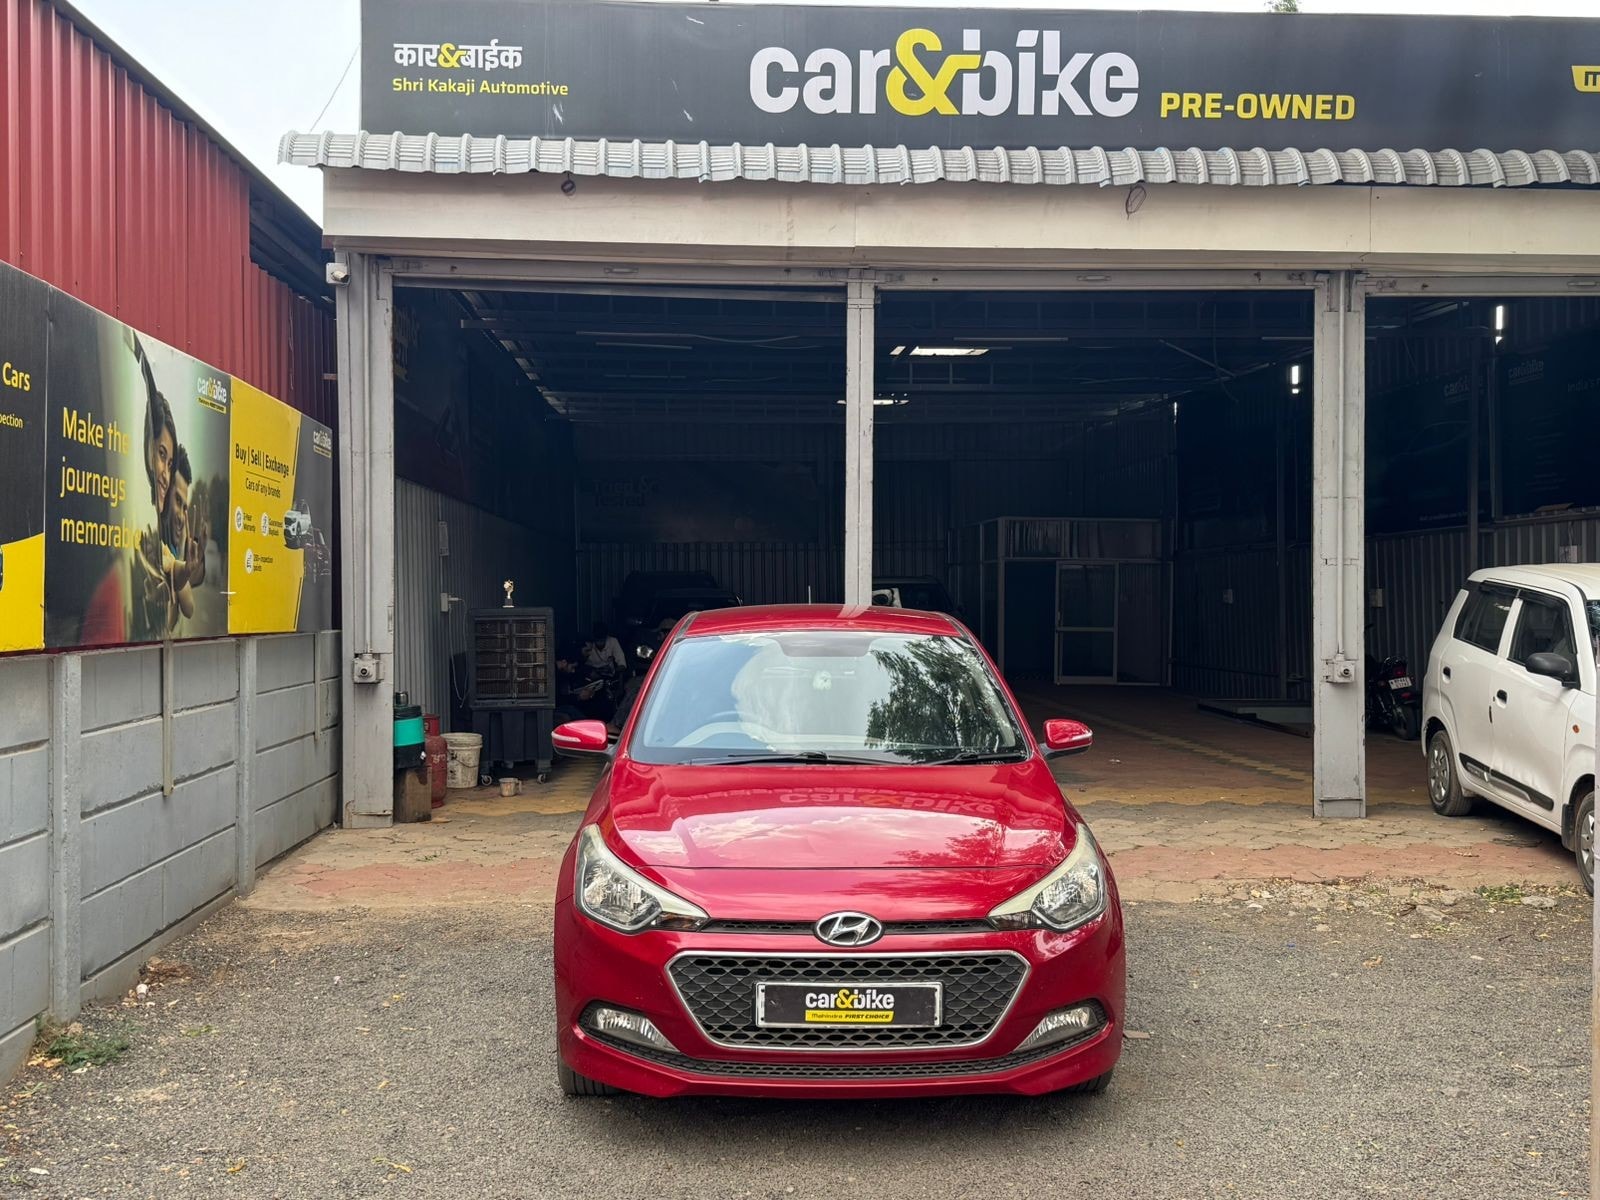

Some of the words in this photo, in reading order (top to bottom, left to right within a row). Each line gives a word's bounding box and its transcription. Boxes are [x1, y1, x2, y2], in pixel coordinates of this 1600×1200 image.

[393, 38, 523, 71] कार&बाईक
[392, 78, 424, 92] Shri
[428, 79, 475, 96] Kakaji
[479, 80, 569, 96] Automotive
[749, 27, 1140, 118] car&bike
[1160, 92, 1356, 121] PRE-OWNED
[2, 361, 31, 392] Cars
[62, 406, 104, 448] Make
[108, 421, 130, 456] the
[235, 442, 247, 464] Buy
[251, 448, 262, 466] Sell
[265, 454, 289, 478] Exchange
[60, 455, 127, 508] journeys
[805, 988, 895, 1009] car&bike
